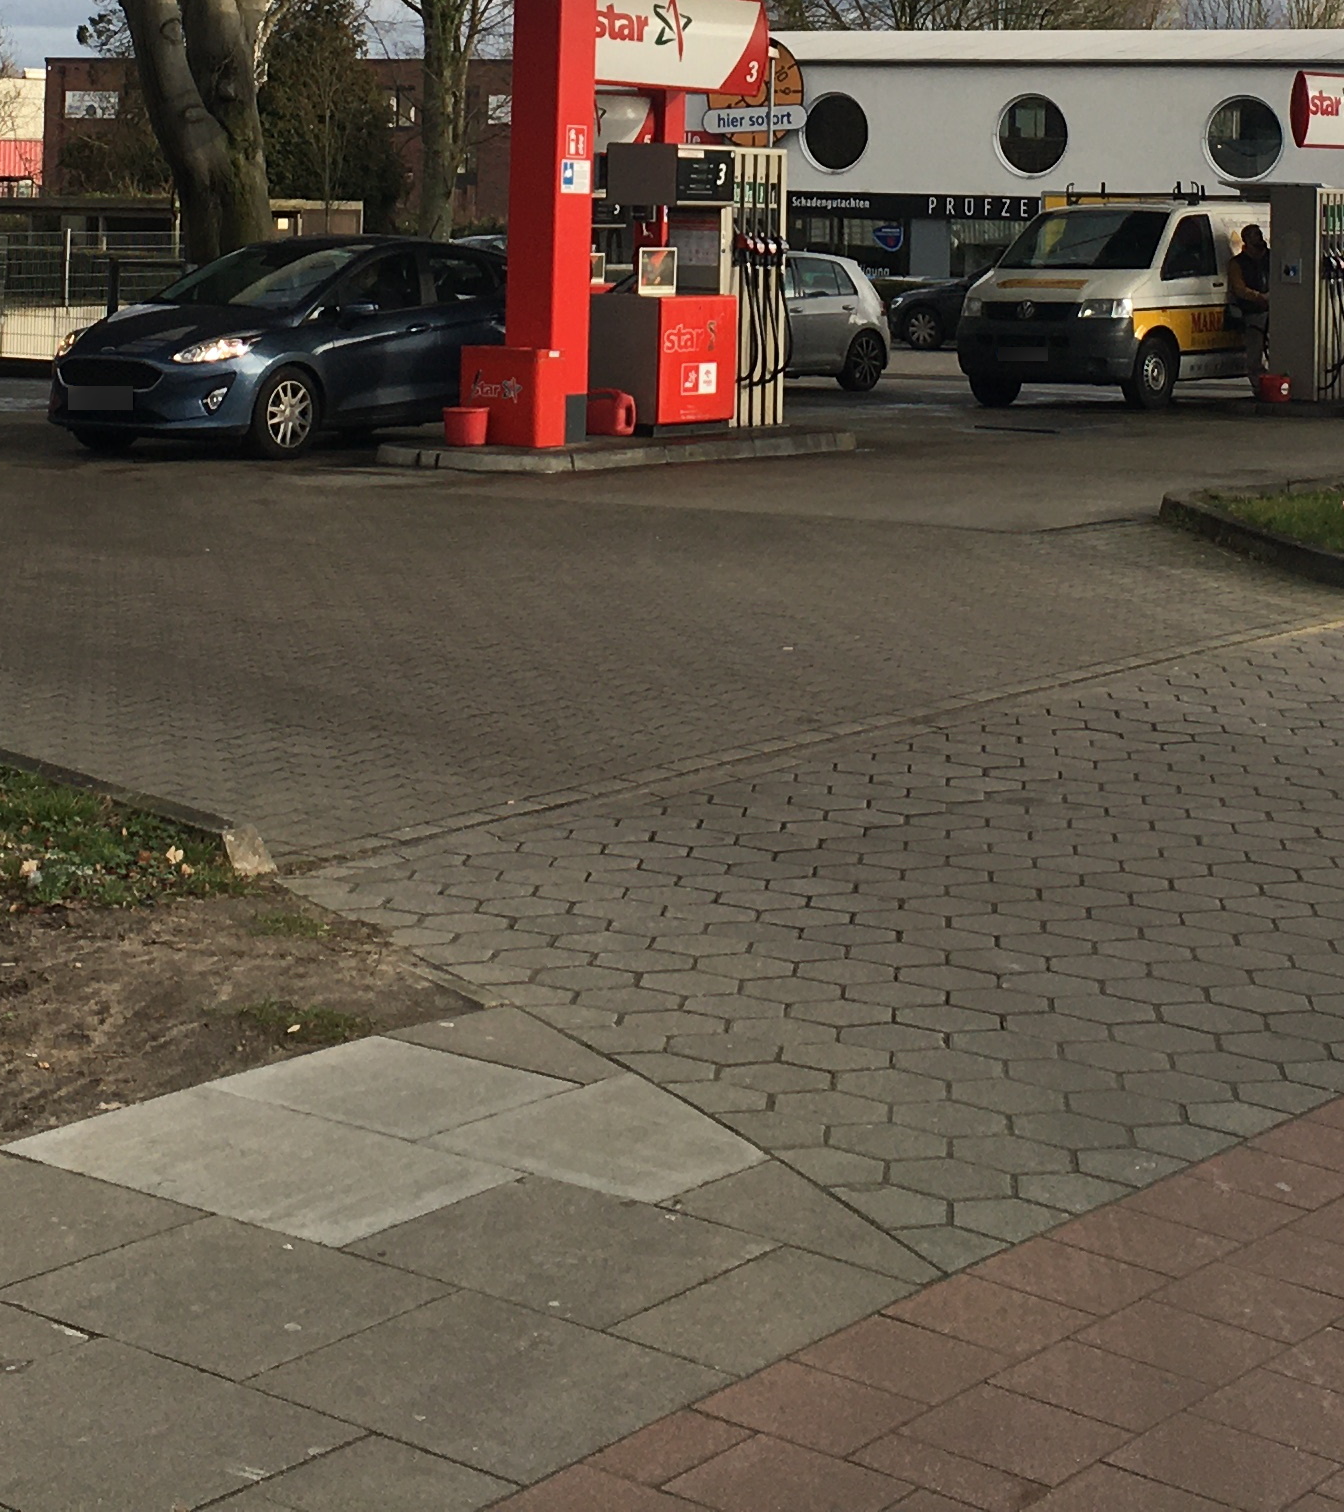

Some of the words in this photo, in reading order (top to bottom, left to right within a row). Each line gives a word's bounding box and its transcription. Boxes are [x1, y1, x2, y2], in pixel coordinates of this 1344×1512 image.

[595, 3, 649, 43] star
[746, 61, 759, 83] 3
[1310, 90, 1342, 116] star
[717, 113, 745, 128] hier
[716, 163, 727, 185] 3
[791, 196, 871, 210] Schadengutachten
[664, 324, 704, 353] star
